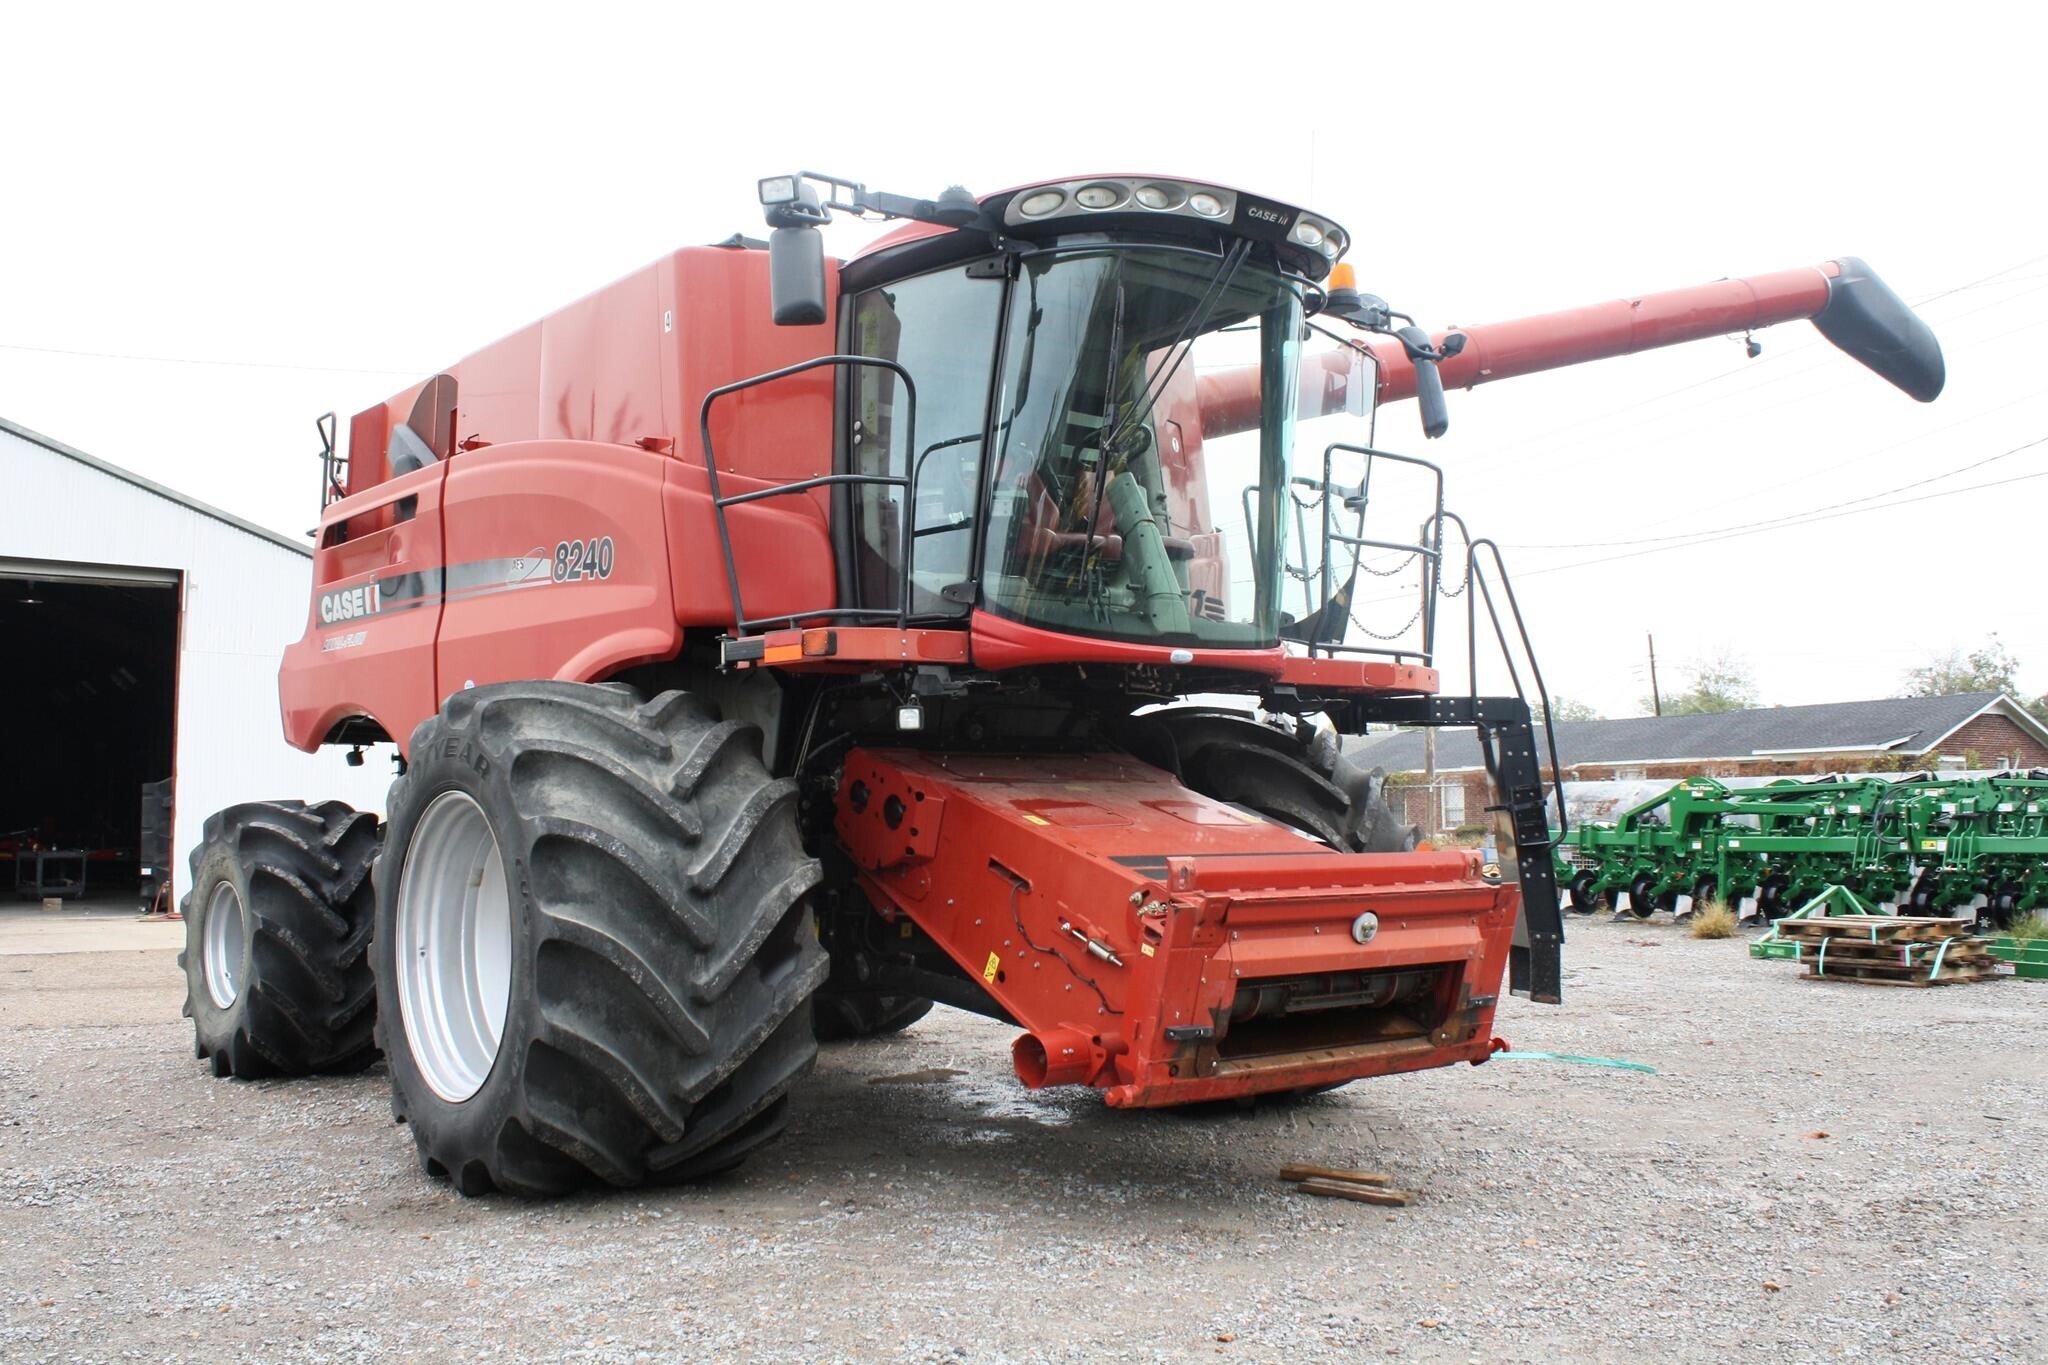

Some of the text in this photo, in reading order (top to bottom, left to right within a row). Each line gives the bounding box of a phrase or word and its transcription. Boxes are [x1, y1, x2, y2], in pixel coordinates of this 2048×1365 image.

[1248, 207, 1277, 222] CASE
[552, 536, 615, 583] 8240
[321, 588, 364, 623] CASE
